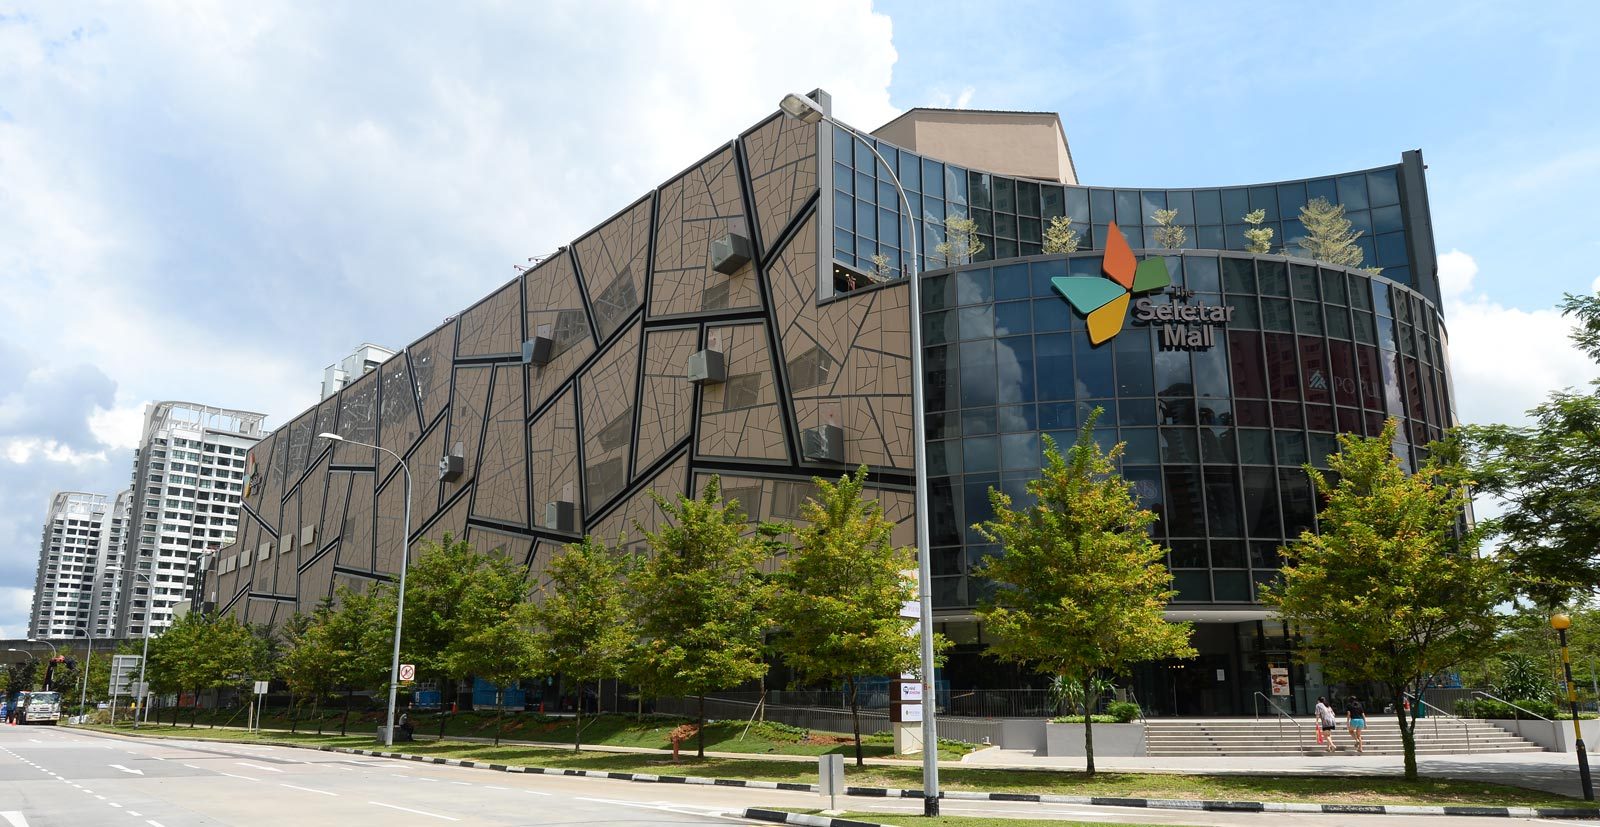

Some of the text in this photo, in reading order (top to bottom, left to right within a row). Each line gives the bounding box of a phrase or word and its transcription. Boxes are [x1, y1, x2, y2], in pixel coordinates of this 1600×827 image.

[1172, 286, 1194, 298] The
[1136, 298, 1234, 321] Seletar
[1164, 324, 1214, 347] Mall
